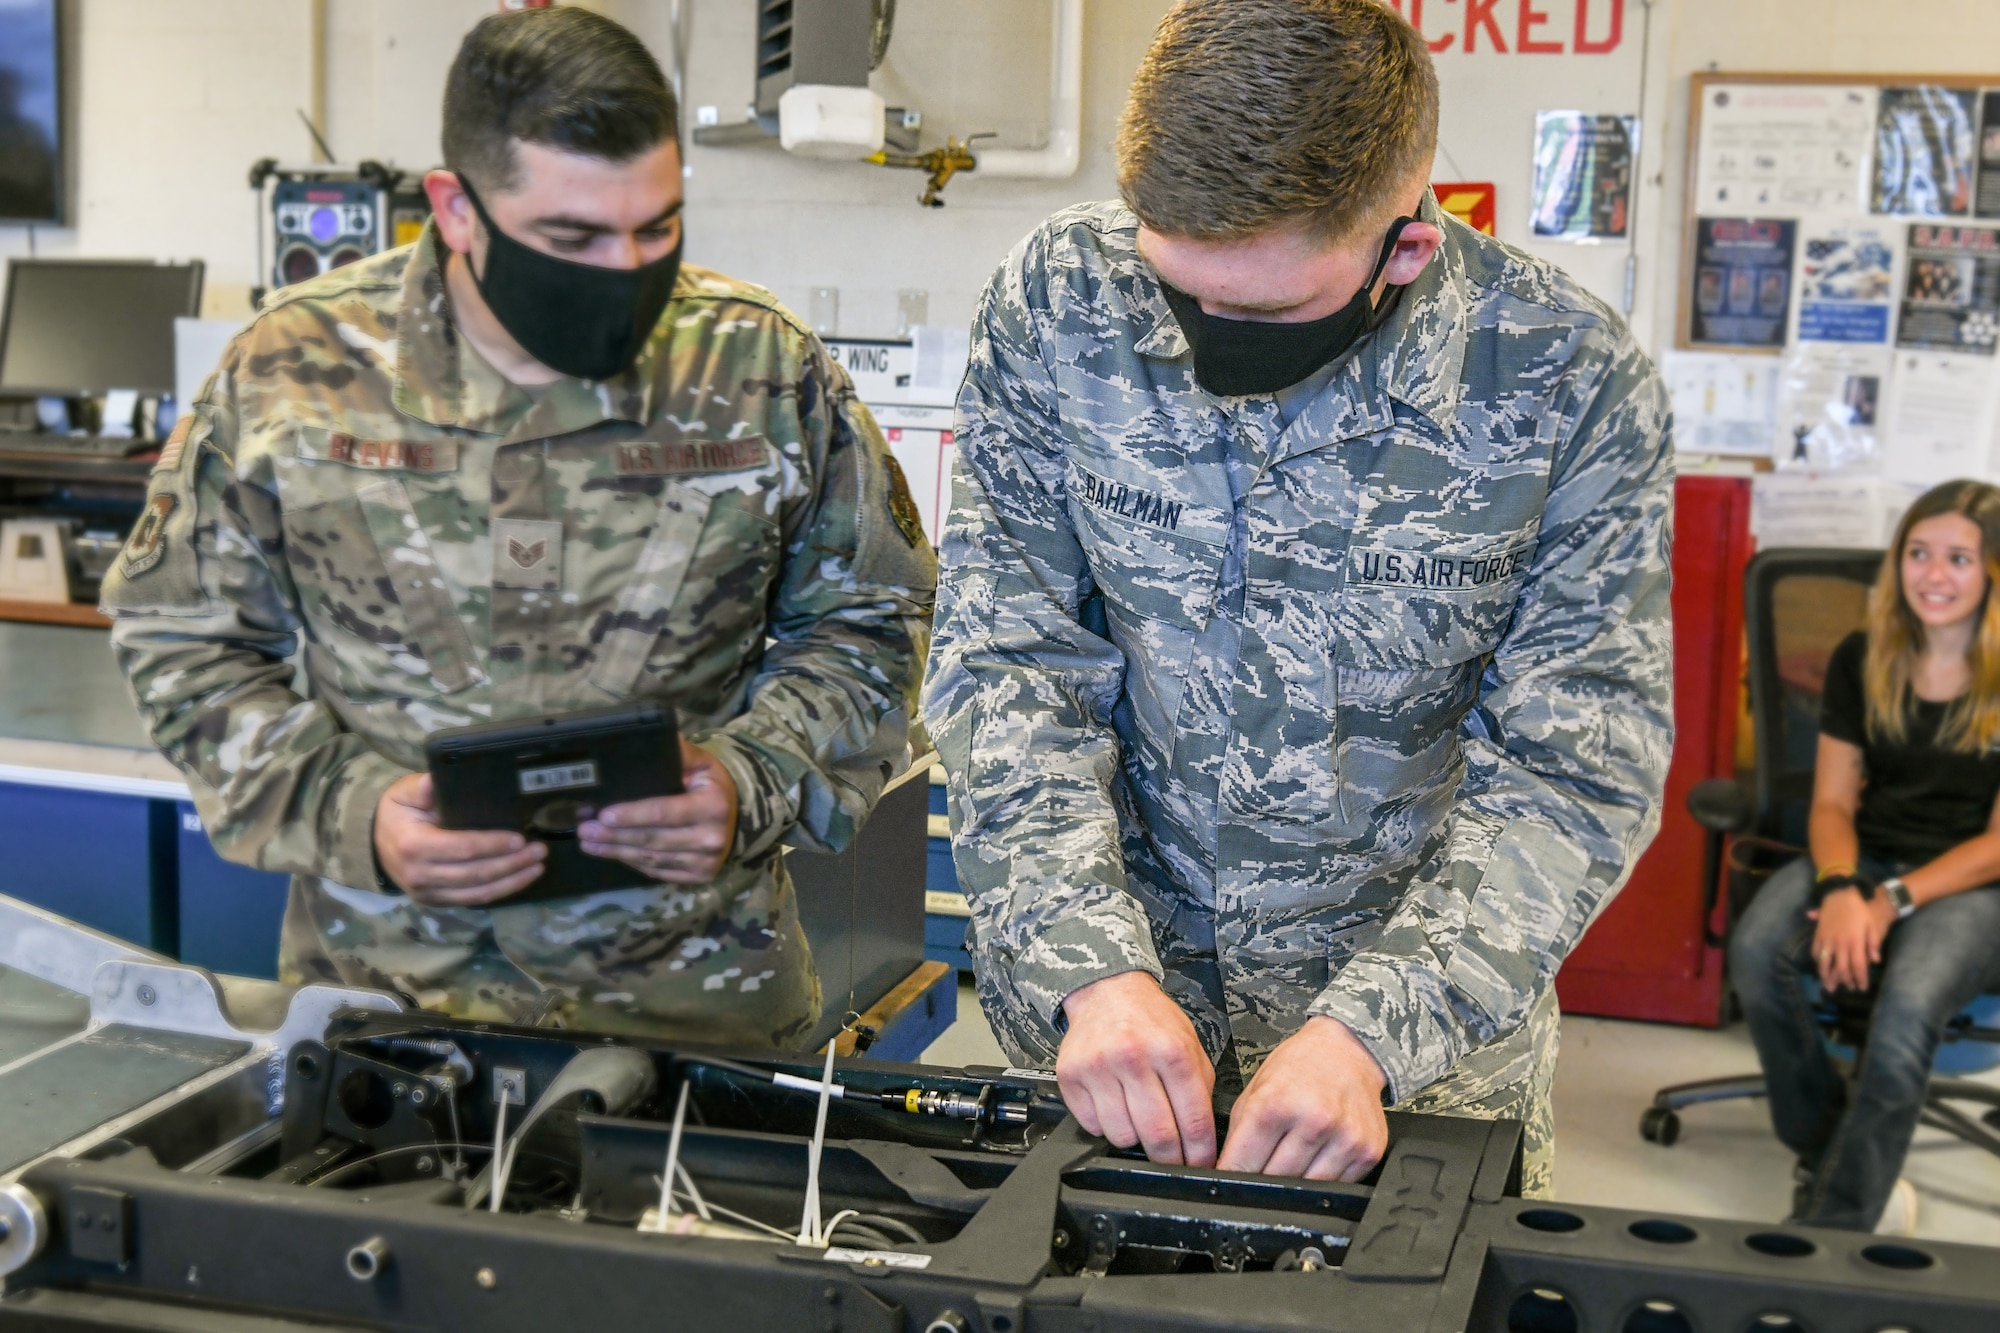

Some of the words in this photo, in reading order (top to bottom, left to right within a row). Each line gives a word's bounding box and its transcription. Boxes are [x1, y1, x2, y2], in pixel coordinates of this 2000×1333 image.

[1393, 0, 1625, 54] CKED
[848, 347, 889, 373] WING
[1086, 473, 1183, 531] BAHLMAN
[1363, 552, 1406, 584] U.S.
[1412, 557, 1454, 587] AIR
[1458, 549, 1528, 587] FORCE
